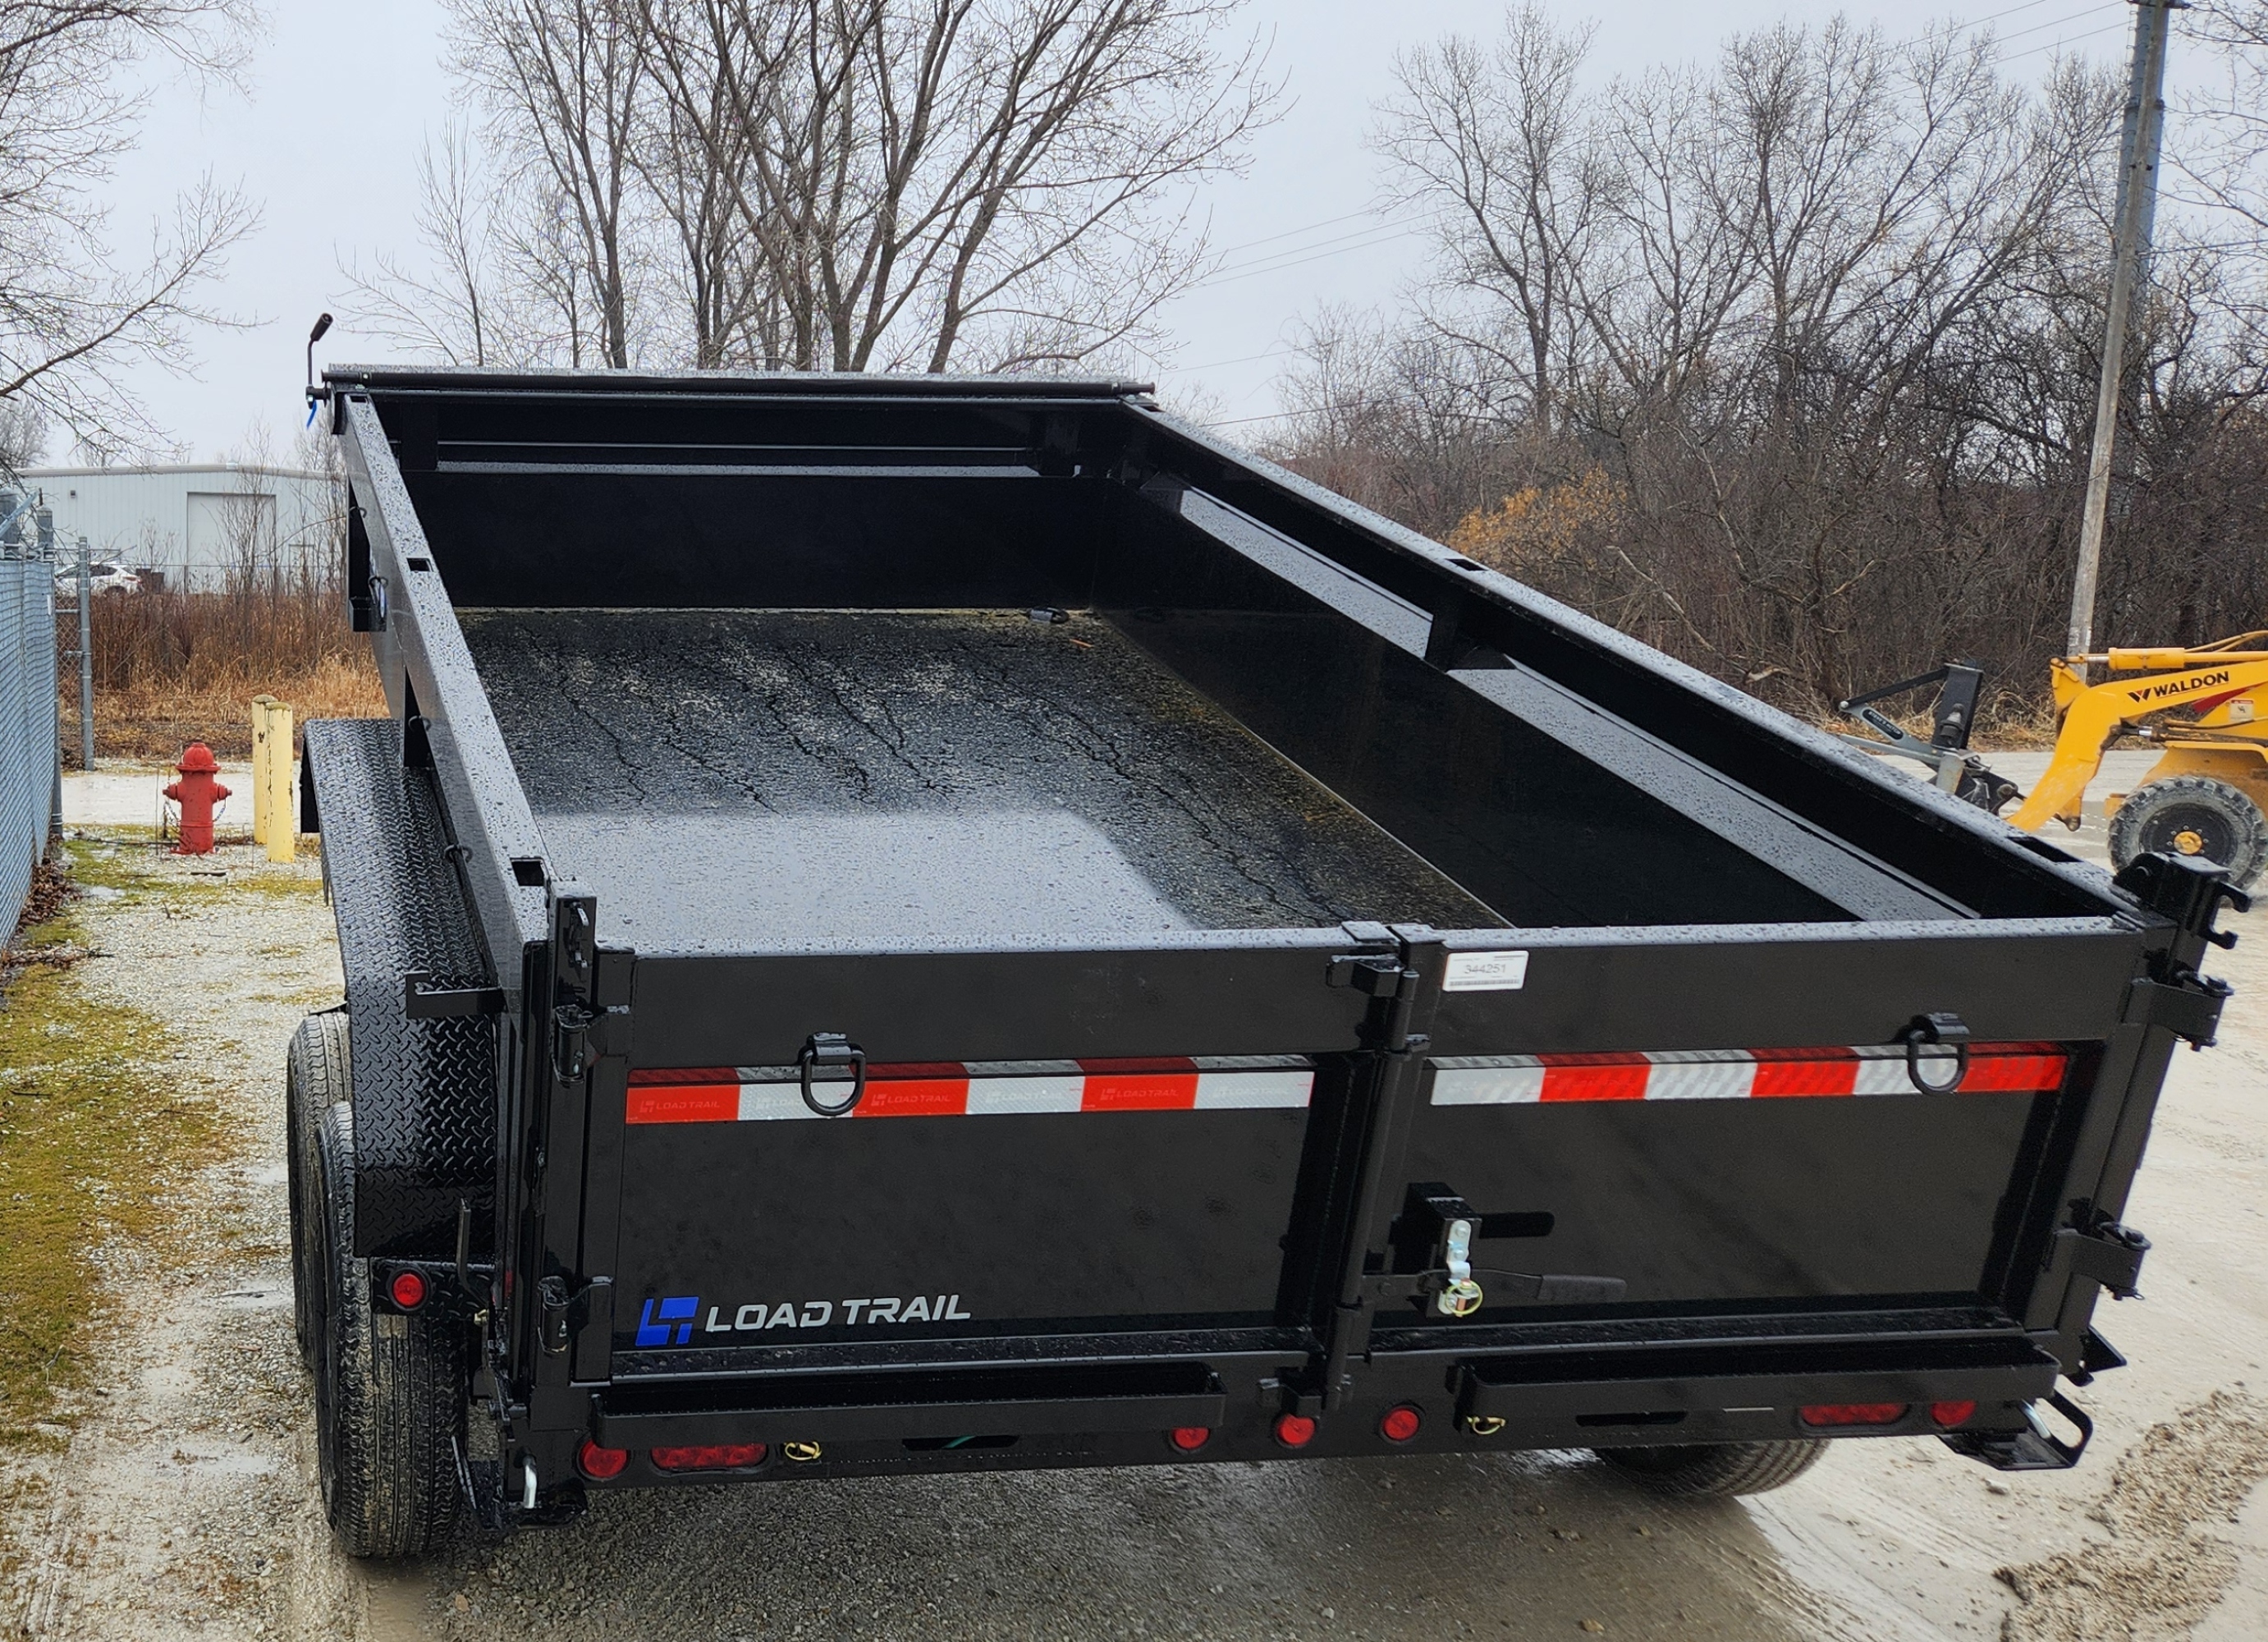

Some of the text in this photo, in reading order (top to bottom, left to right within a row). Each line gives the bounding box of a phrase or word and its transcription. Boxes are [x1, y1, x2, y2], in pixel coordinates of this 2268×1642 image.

[2153, 671, 2229, 697] WALDON
[1464, 964, 1506, 975] 344251
[1148, 1089, 1179, 1097] TRAIL
[887, 1095, 919, 1103] LOAD
[657, 1101, 687, 1110] LOAD
[704, 1300, 832, 1332] LOAD
[841, 1295, 971, 1325] TRAIL
